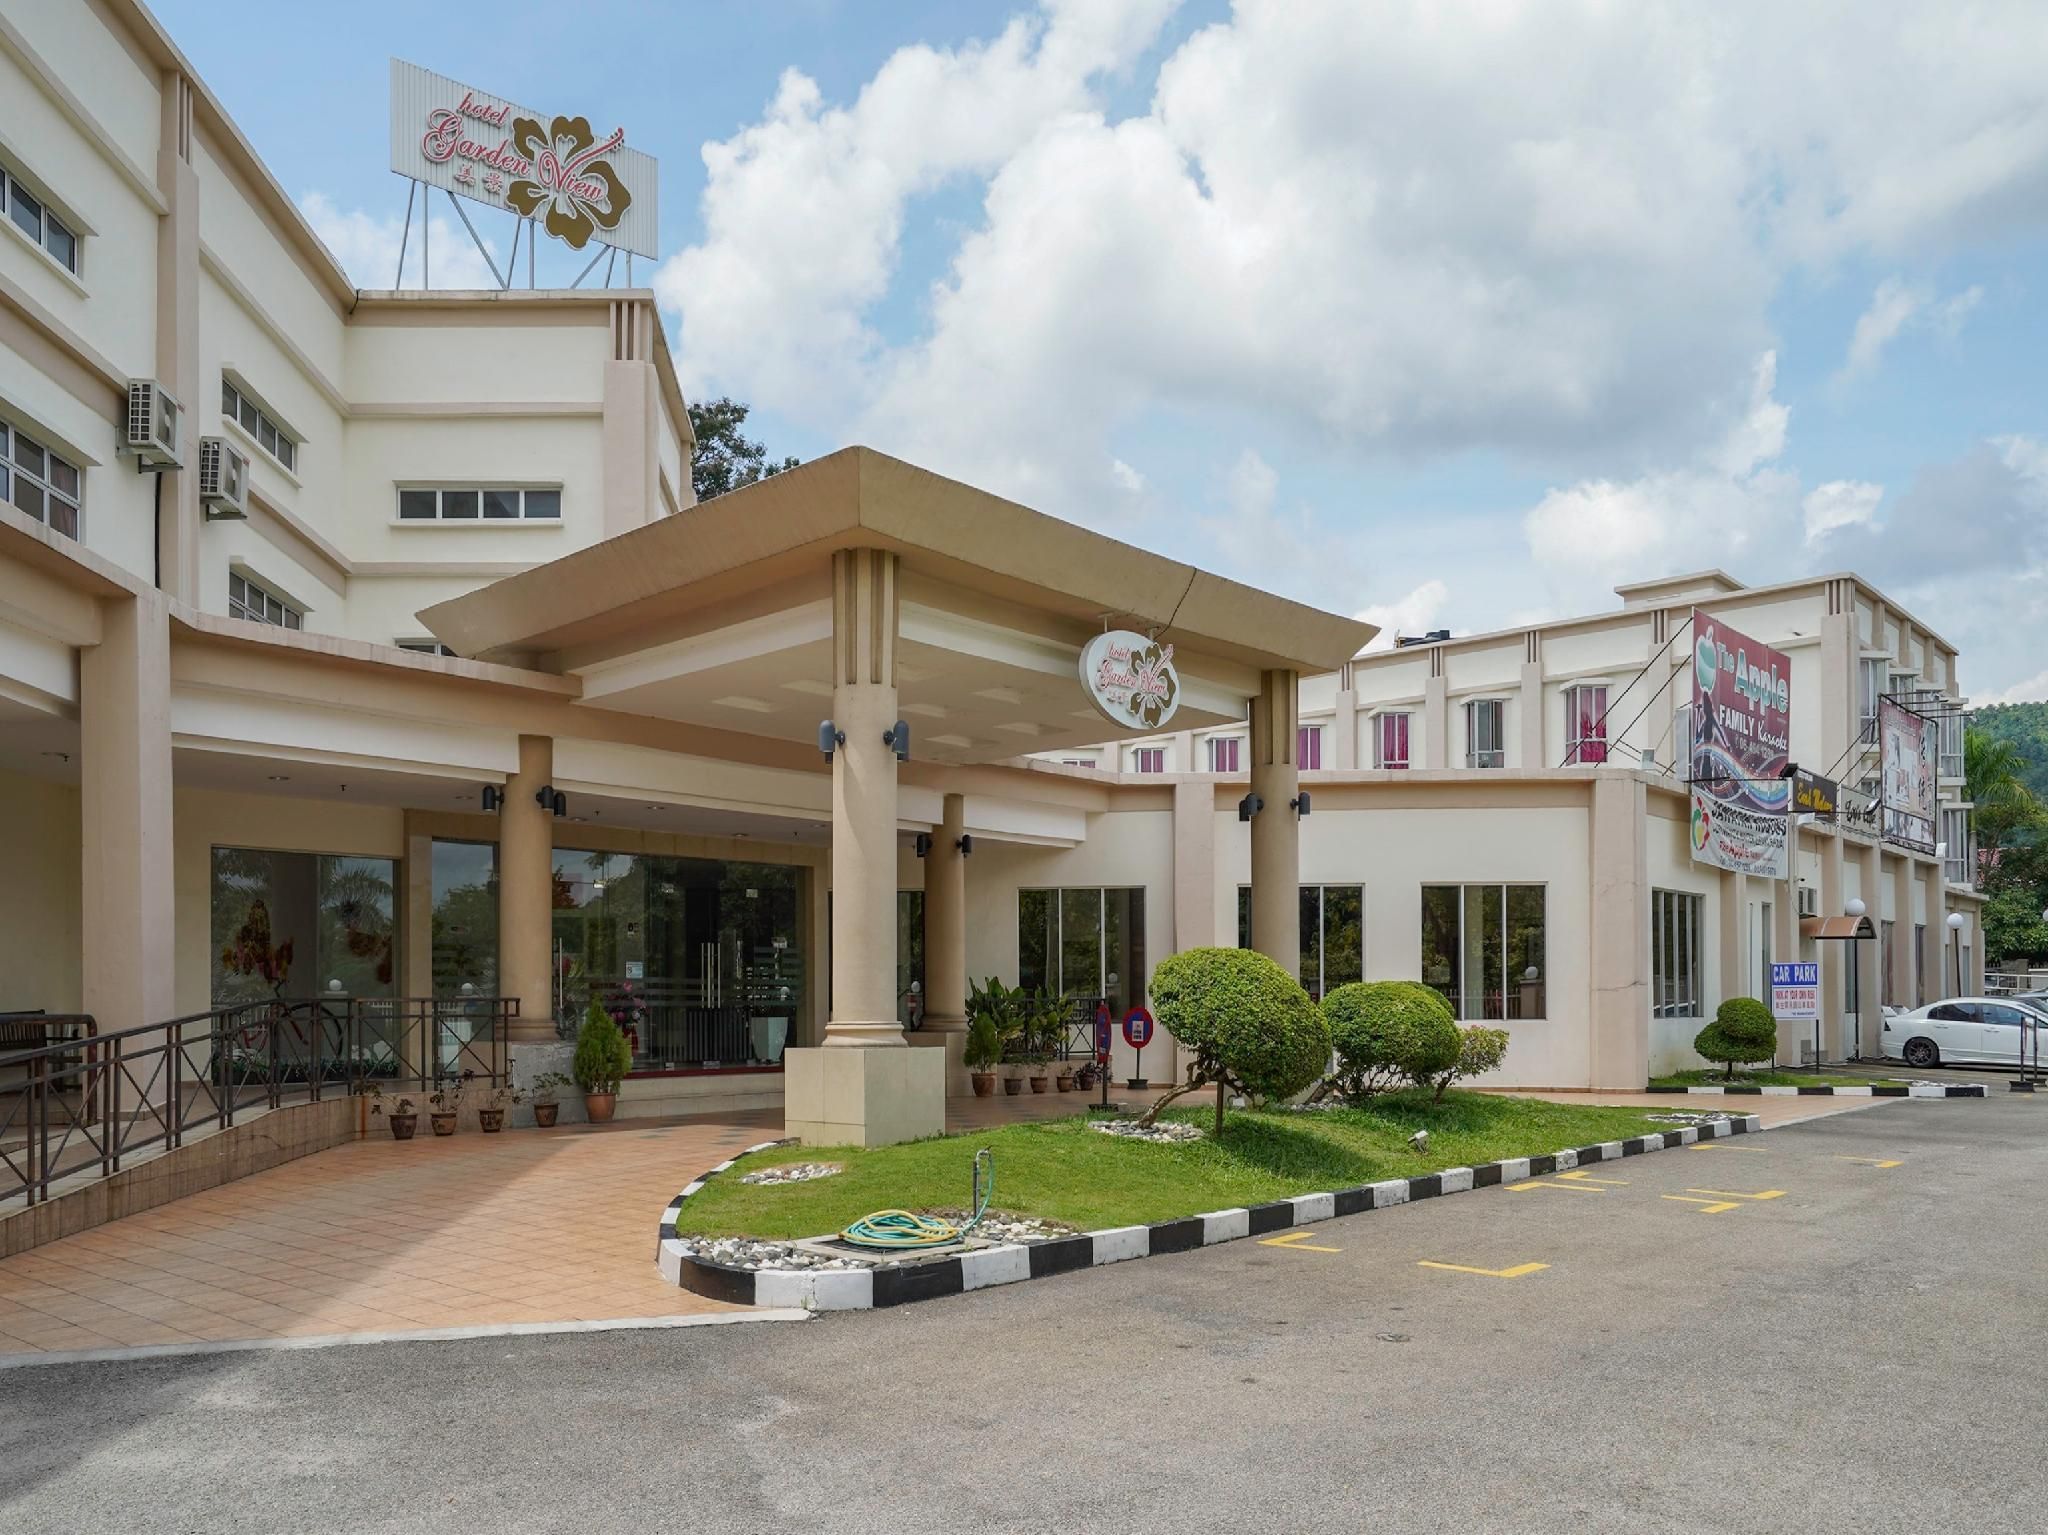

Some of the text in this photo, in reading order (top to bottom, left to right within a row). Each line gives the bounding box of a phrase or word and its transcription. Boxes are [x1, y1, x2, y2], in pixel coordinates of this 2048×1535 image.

[457, 92, 510, 127] hotel
[421, 108, 624, 201] Garden View
[1096, 659, 1137, 691] Garden
[1717, 641, 1788, 716] The Apple
[1719, 704, 1755, 737] FAMILY
[1758, 720, 1787, 751] Karaoke
[1773, 964, 1816, 983] CAR PARK
